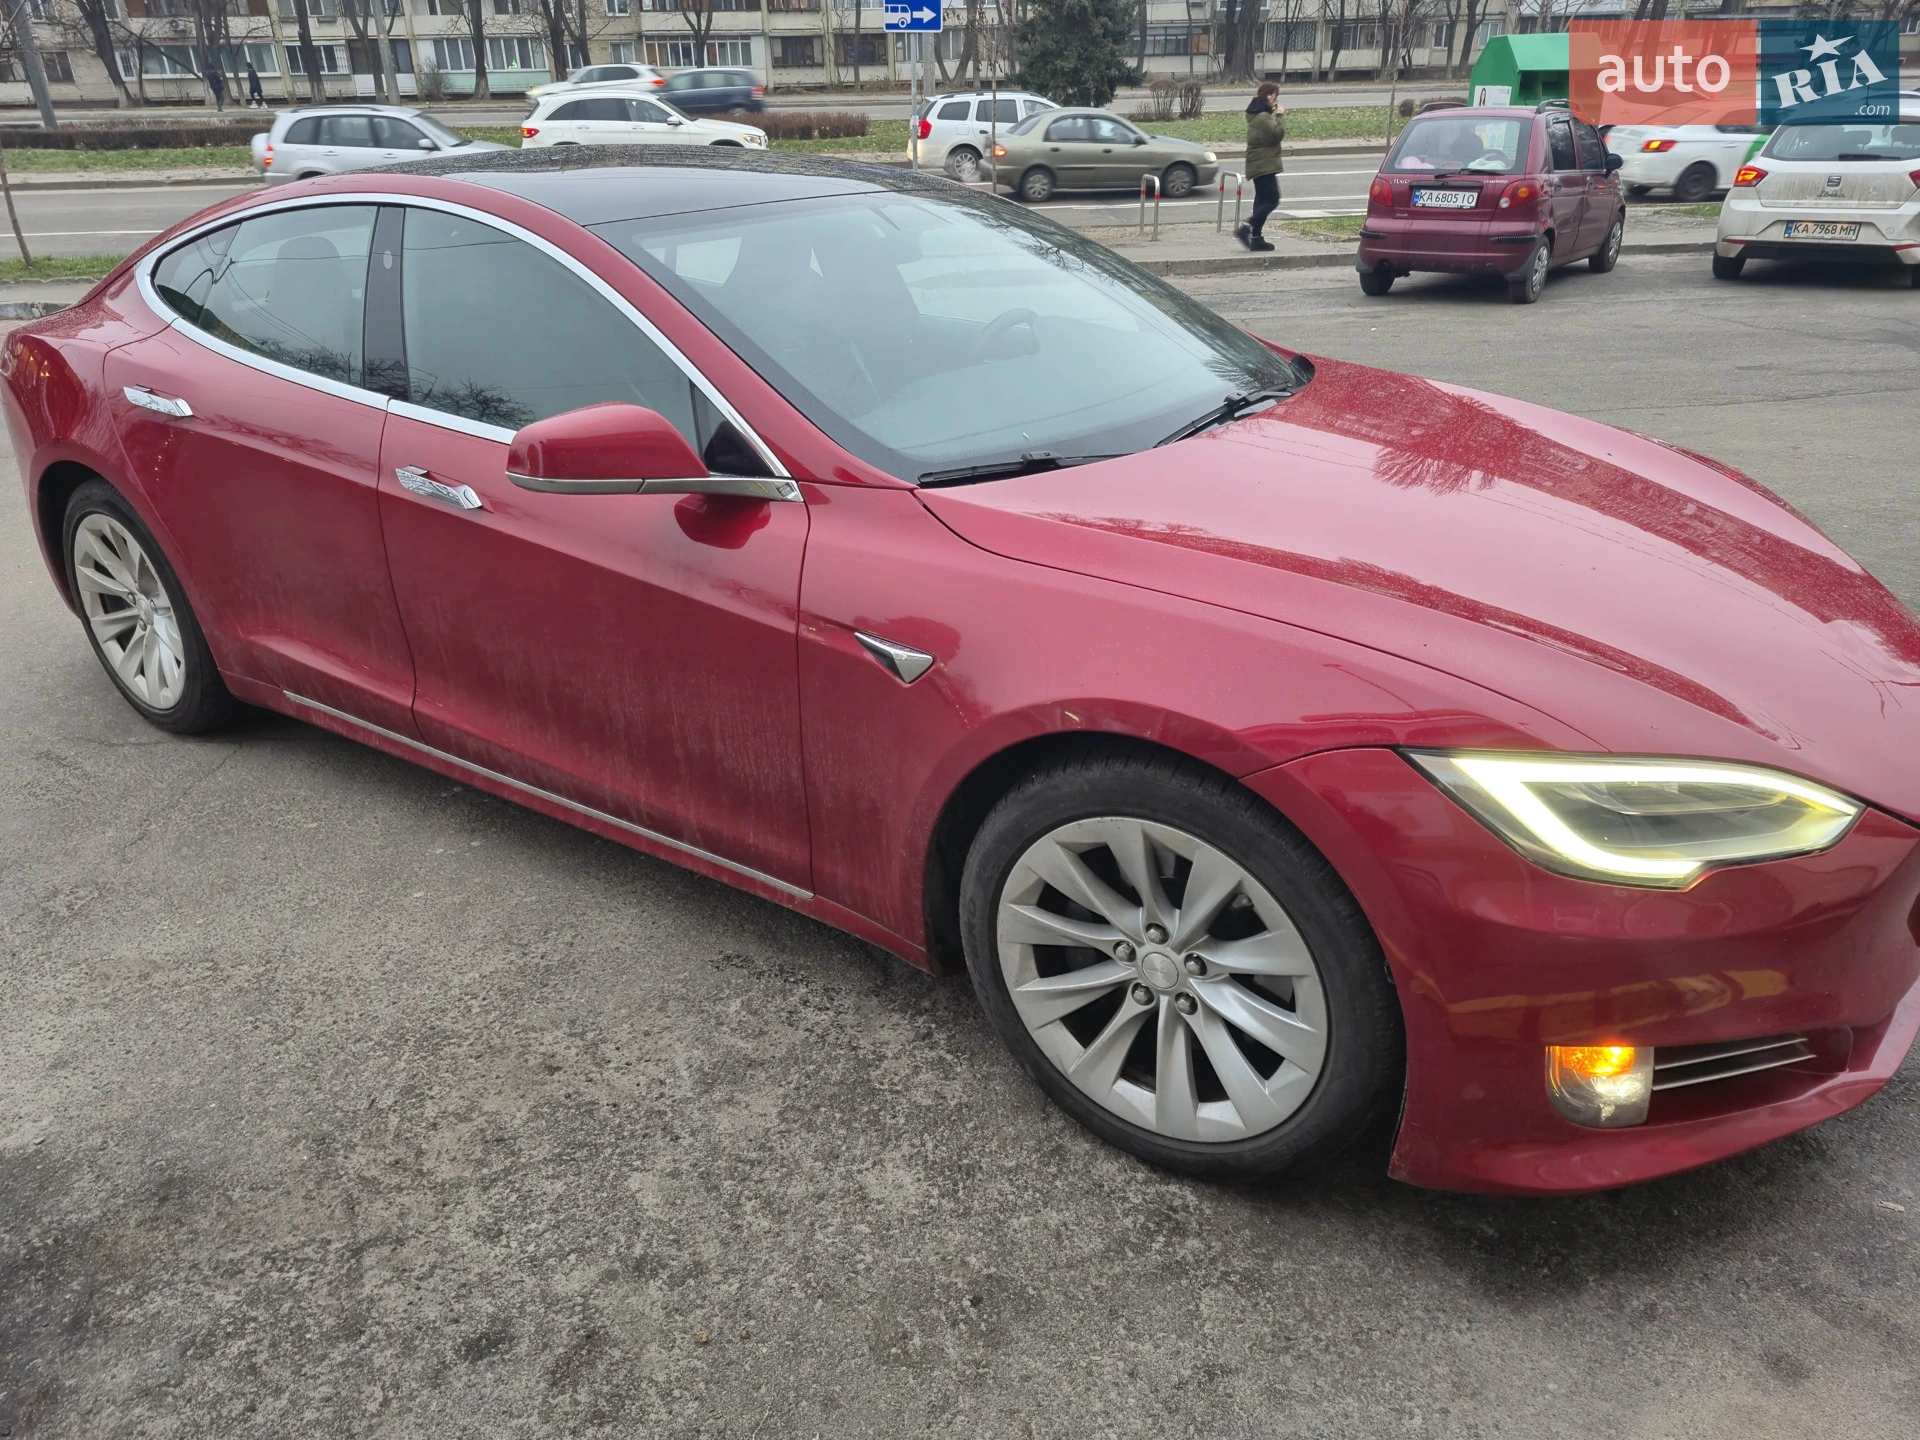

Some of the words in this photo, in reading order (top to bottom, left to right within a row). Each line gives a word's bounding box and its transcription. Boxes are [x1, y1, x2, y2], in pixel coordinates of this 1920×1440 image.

[1419, 191, 1433, 202] KA
[1434, 193, 1459, 204] 6805
[1792, 223, 1809, 234] KA
[1811, 224, 1838, 235] 7968
[1839, 225, 1857, 236] MH
